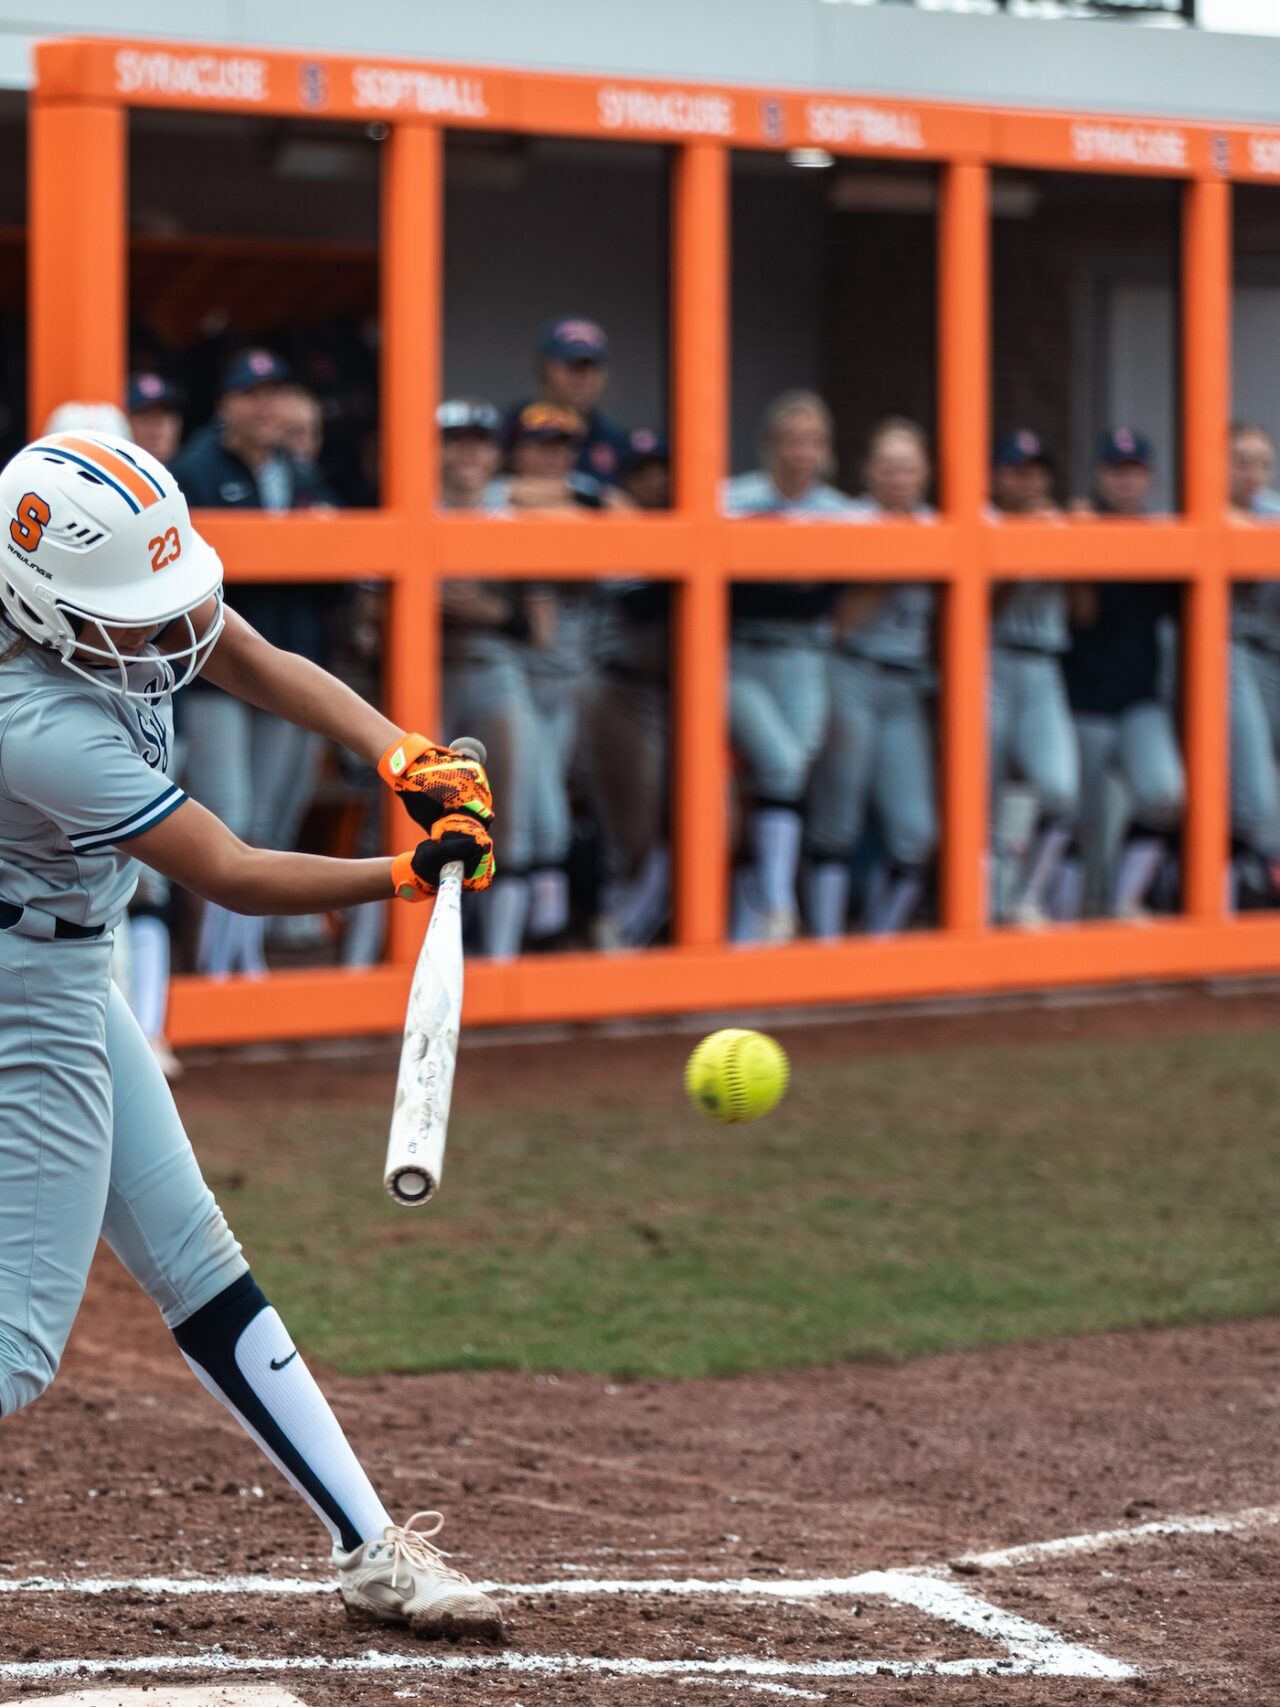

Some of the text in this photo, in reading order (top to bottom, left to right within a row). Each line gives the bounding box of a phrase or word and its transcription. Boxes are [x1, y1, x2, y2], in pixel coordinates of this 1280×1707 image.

[114, 50, 269, 100] SYRACUSE
[352, 66, 489, 118] SOFTBALL
[10, 491, 51, 553] S
[148, 526, 181, 572] 23
[7, 543, 53, 580] RAWLINGS
